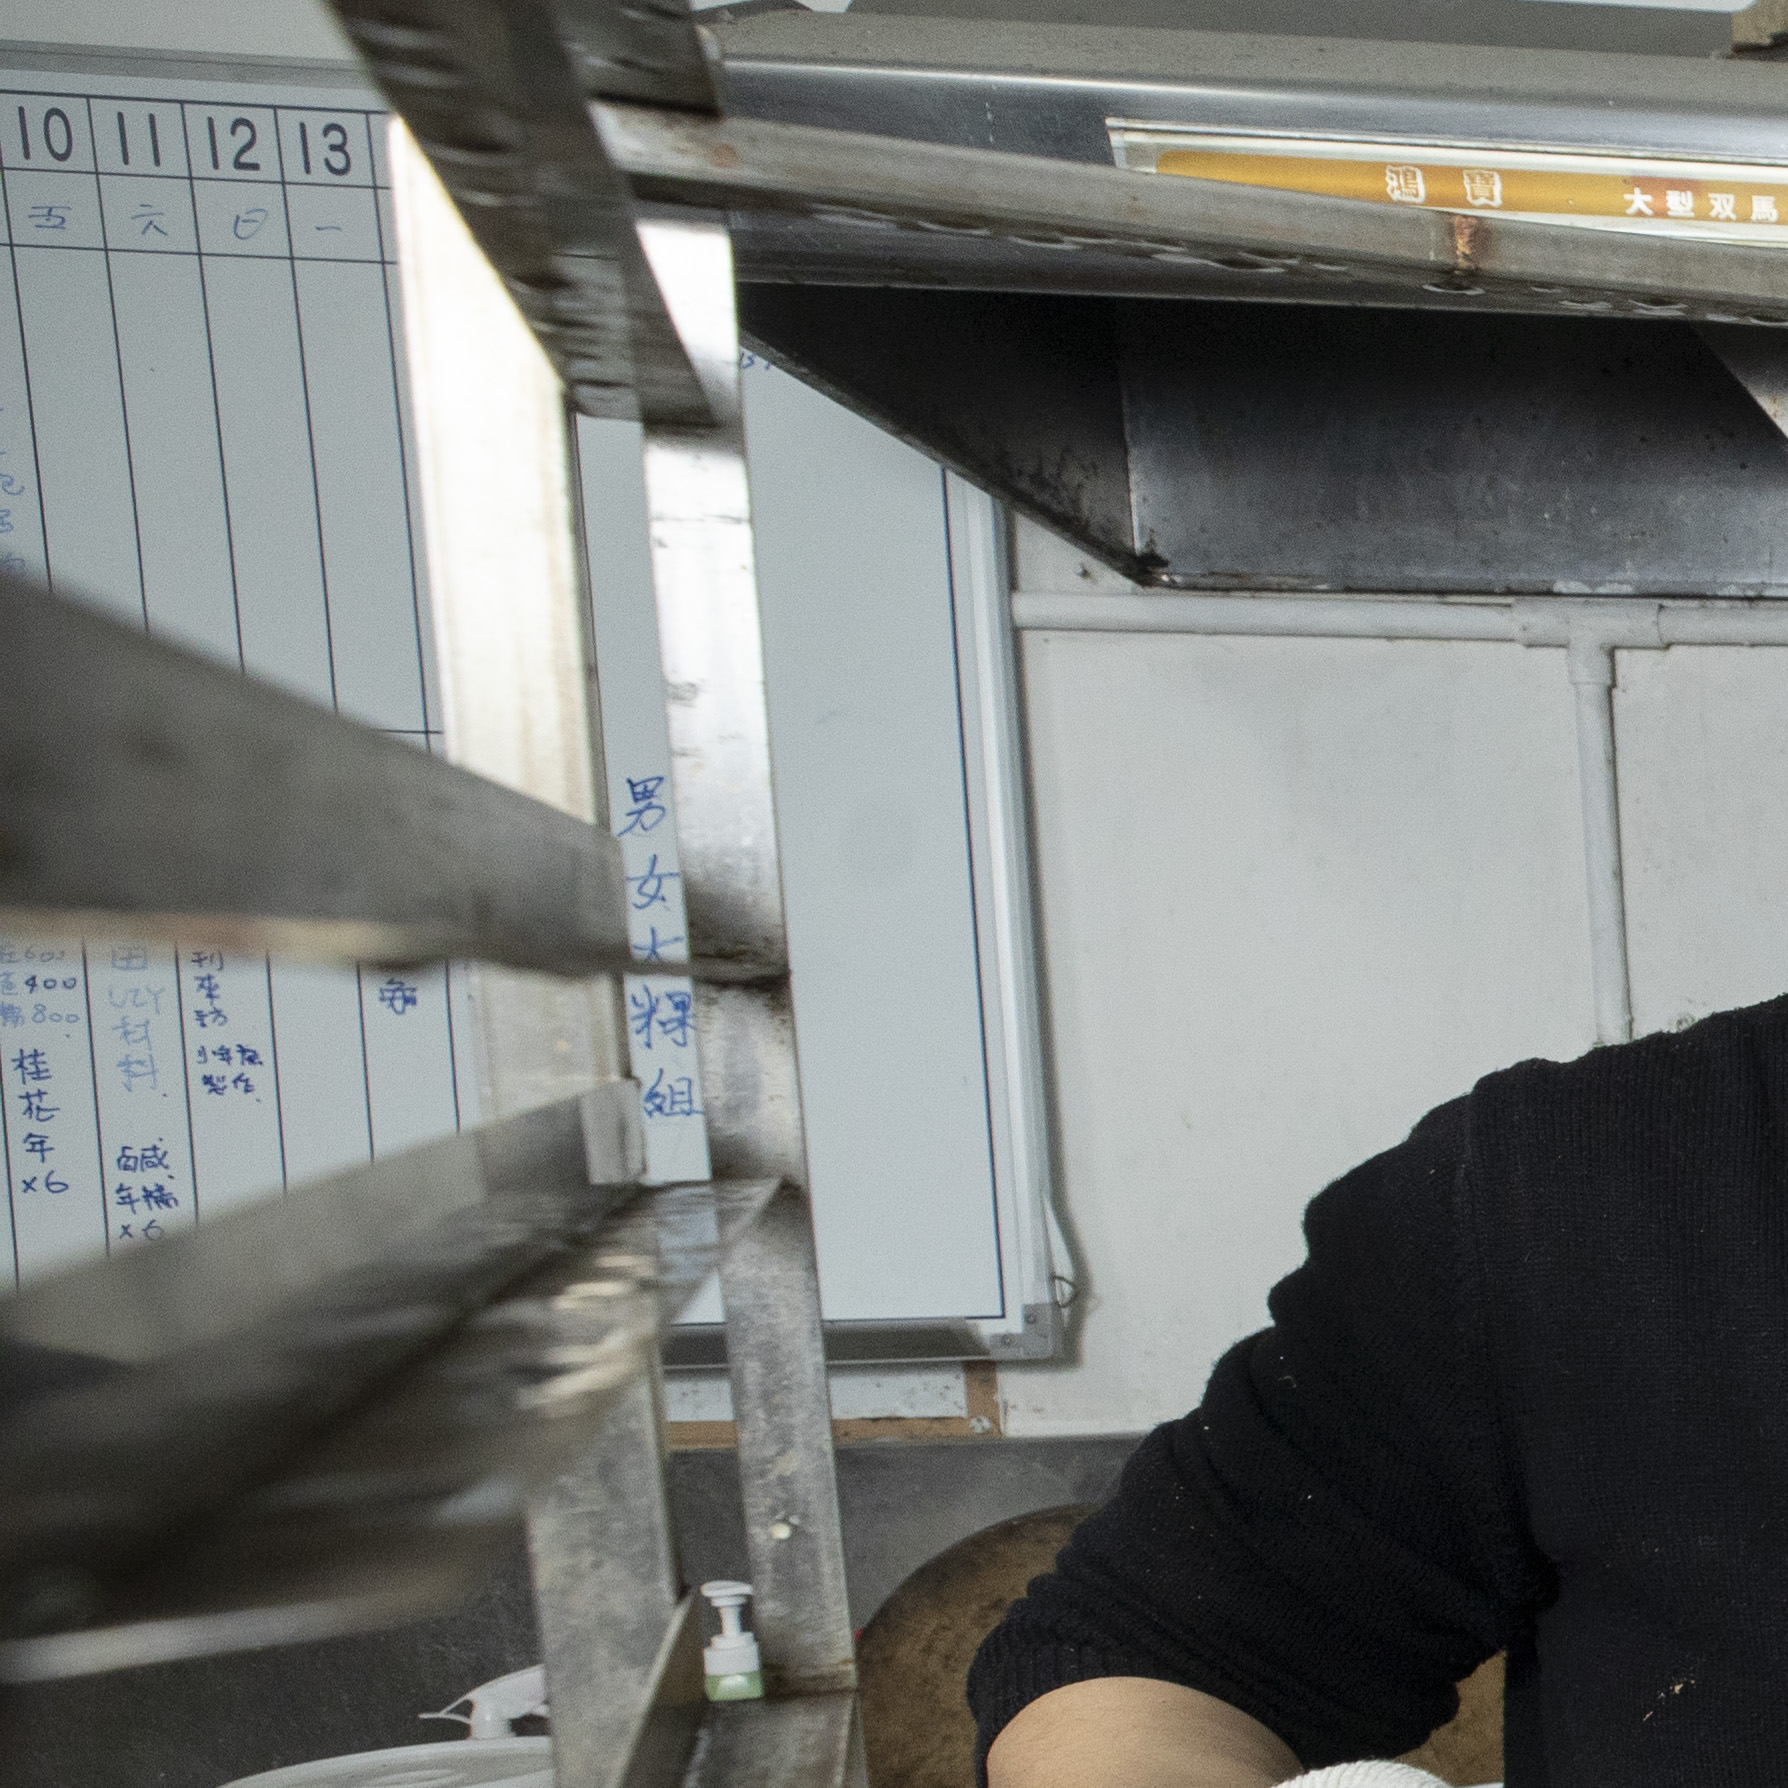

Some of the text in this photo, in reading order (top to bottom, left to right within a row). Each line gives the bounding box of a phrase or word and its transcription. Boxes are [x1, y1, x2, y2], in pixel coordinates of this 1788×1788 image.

[17, 105, 352, 177] 10 11 12 13
[27, 205, 72, 230] 五
[130, 203, 169, 236] 六
[232, 207, 269, 241] 日
